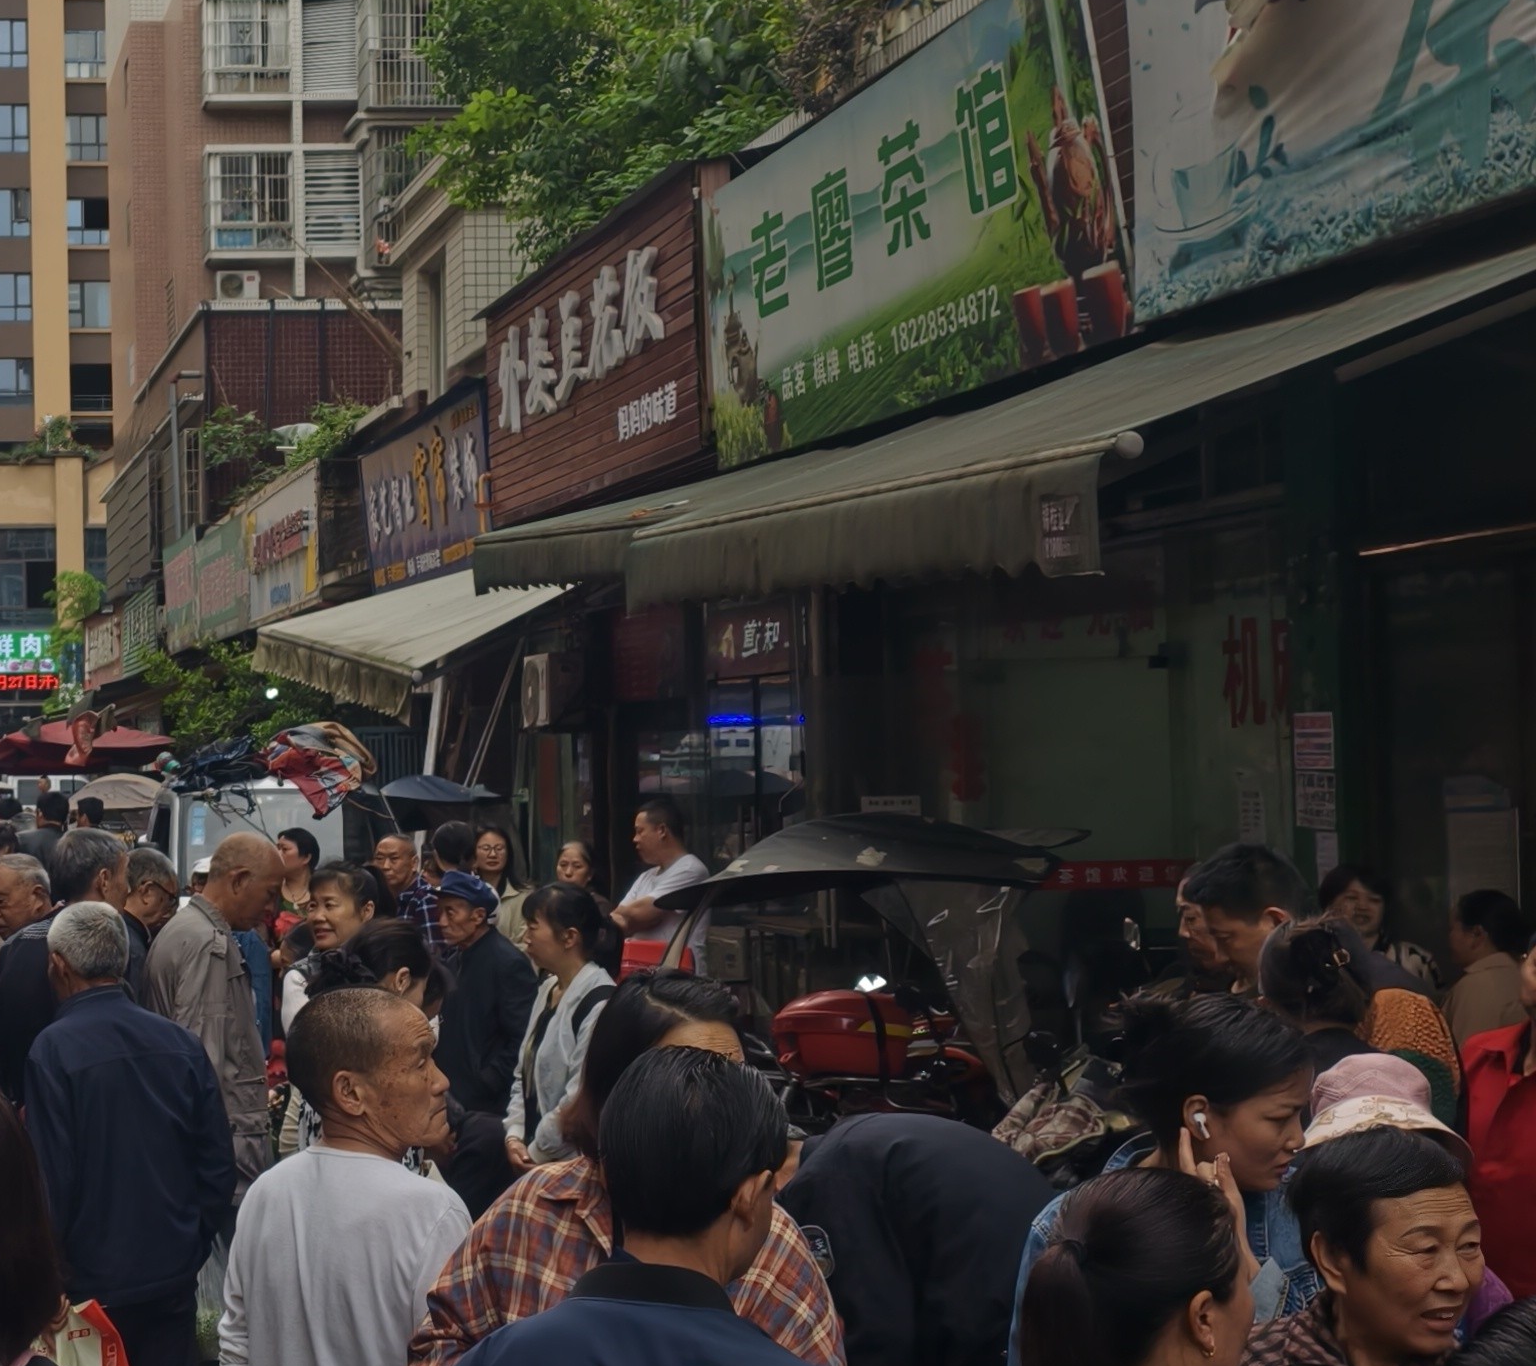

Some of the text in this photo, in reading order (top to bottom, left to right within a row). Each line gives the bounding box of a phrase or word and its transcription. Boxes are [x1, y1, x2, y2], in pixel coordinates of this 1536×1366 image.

[750, 59, 1021, 321] 老廖茶馆
[781, 358, 806, 402] 品茗
[813, 346, 841, 390] 棋牌
[891, 284, 1002, 356] 18228534872
[617, 380, 678, 443] 妈妈的味道
